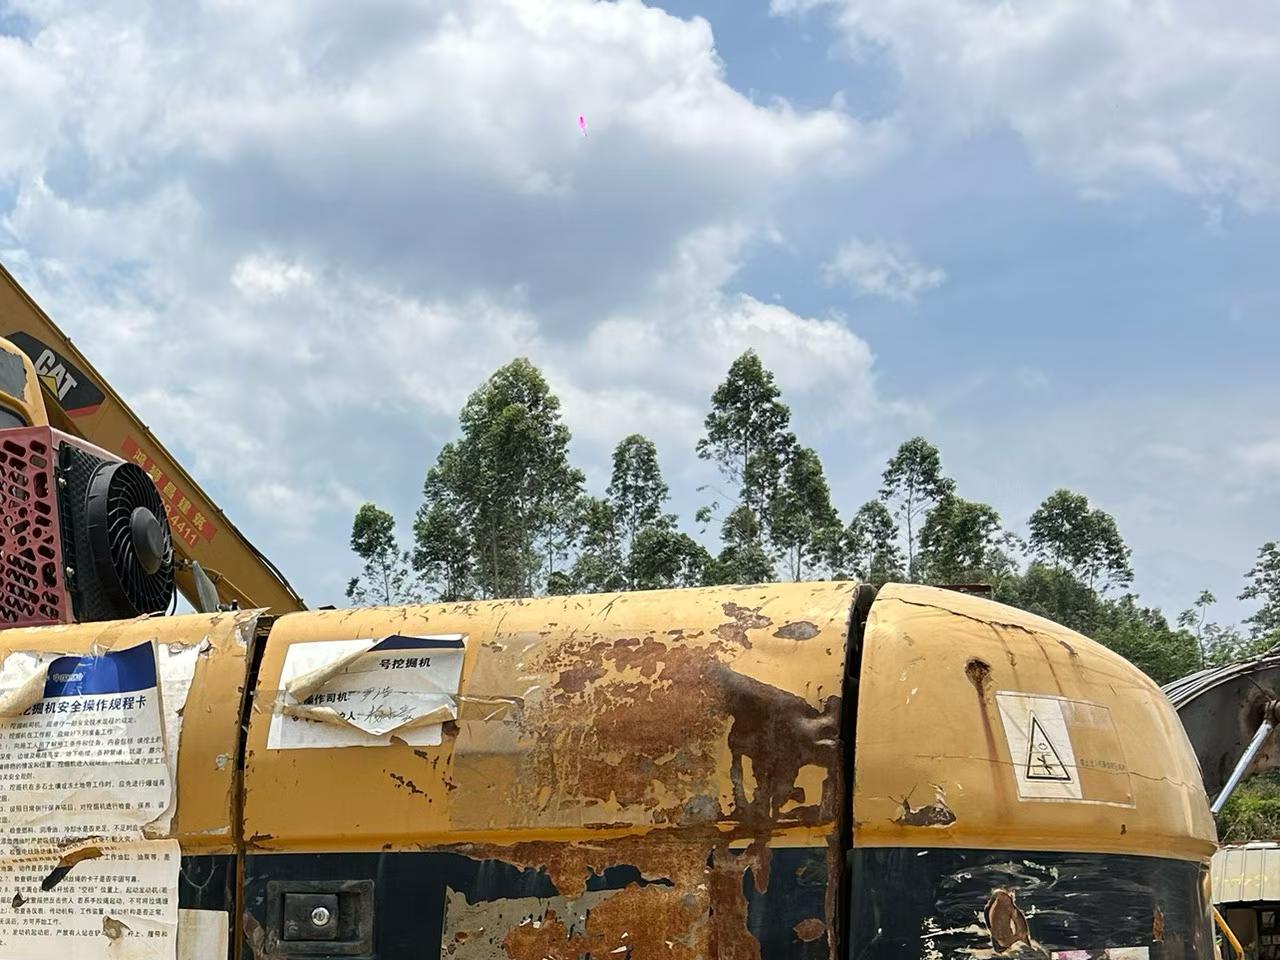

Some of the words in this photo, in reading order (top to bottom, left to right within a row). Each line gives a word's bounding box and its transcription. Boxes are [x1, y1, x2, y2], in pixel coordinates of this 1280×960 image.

[34, 349, 78, 401] CAT
[170, 515, 198, 547] 4411
[379, 657, 431, 670] 号挖掘机
